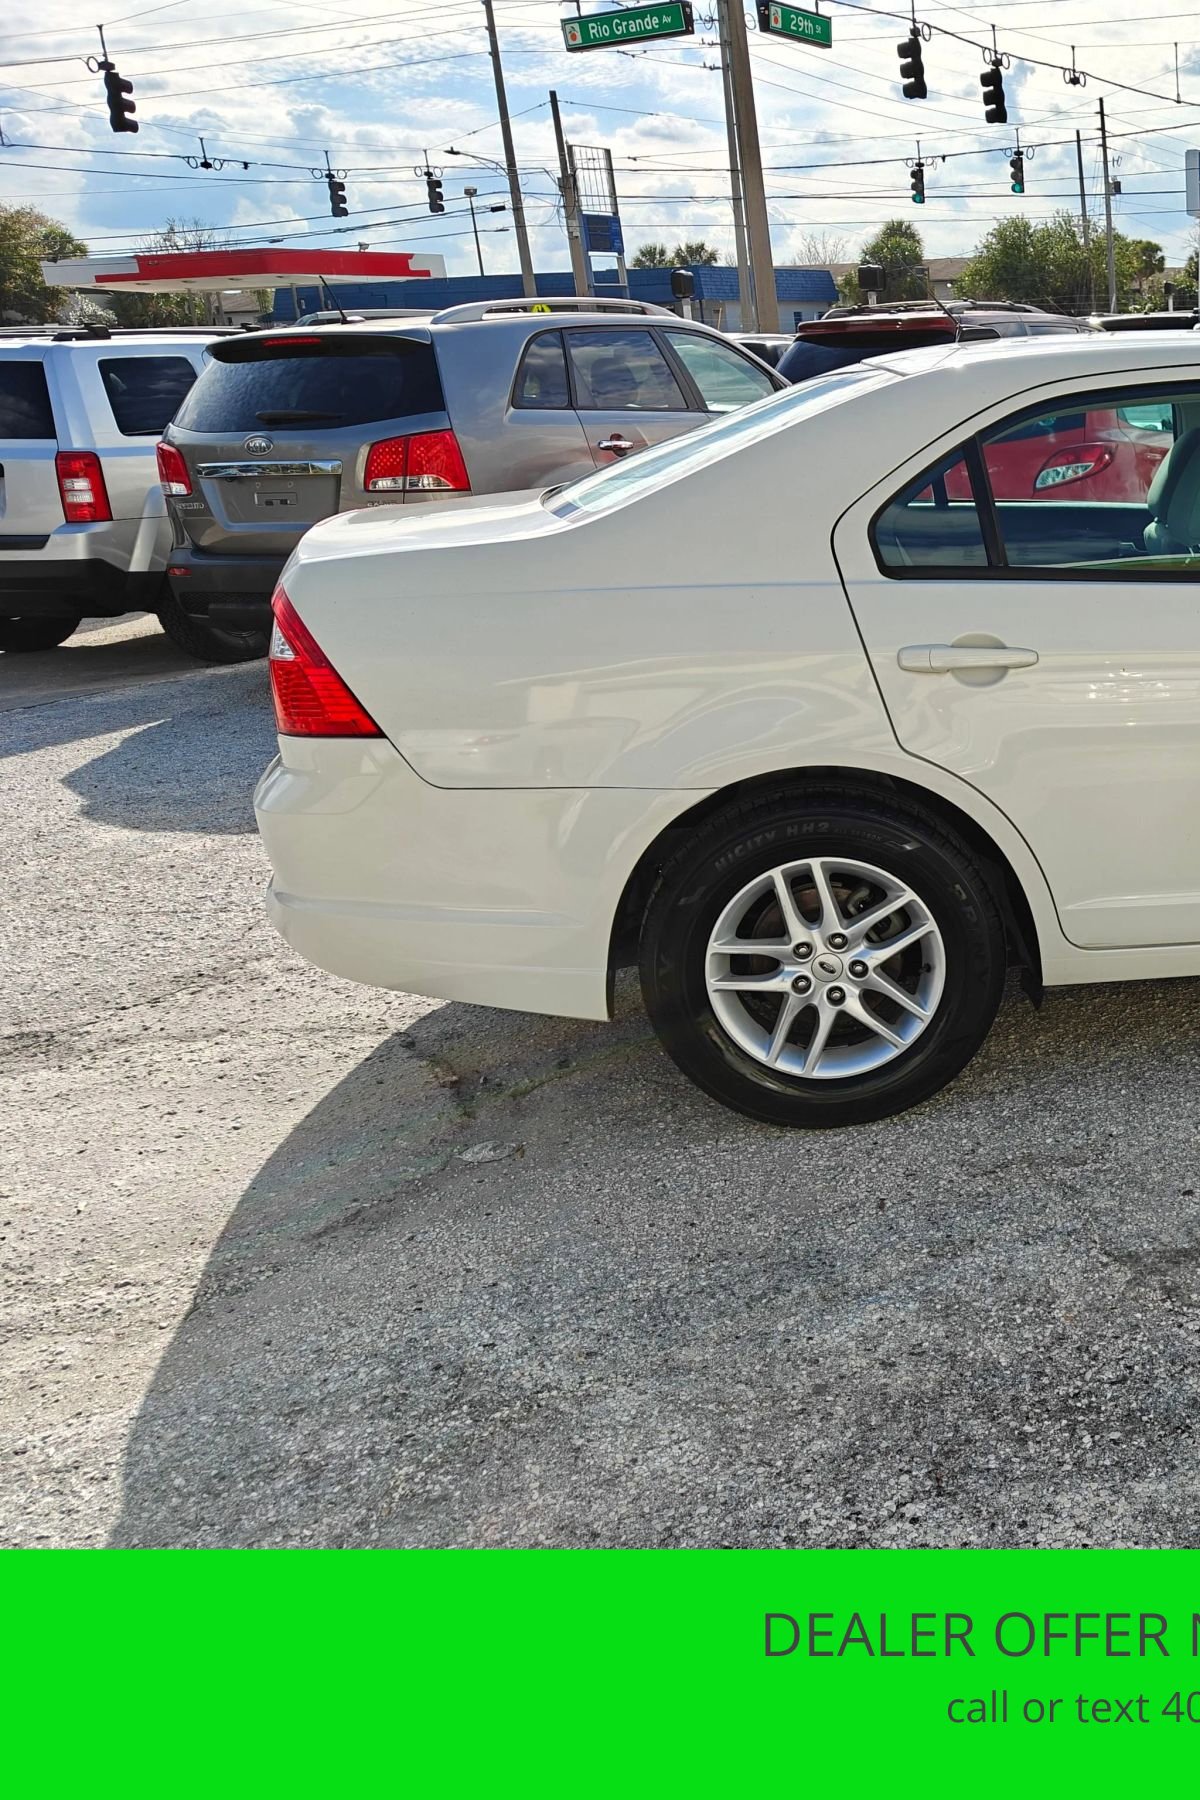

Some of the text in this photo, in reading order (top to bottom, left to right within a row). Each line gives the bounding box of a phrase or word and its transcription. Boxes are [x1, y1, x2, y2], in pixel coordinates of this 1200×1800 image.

[588, 15, 673, 39] Rio Grande Av
[790, 14, 822, 35] 29th St
